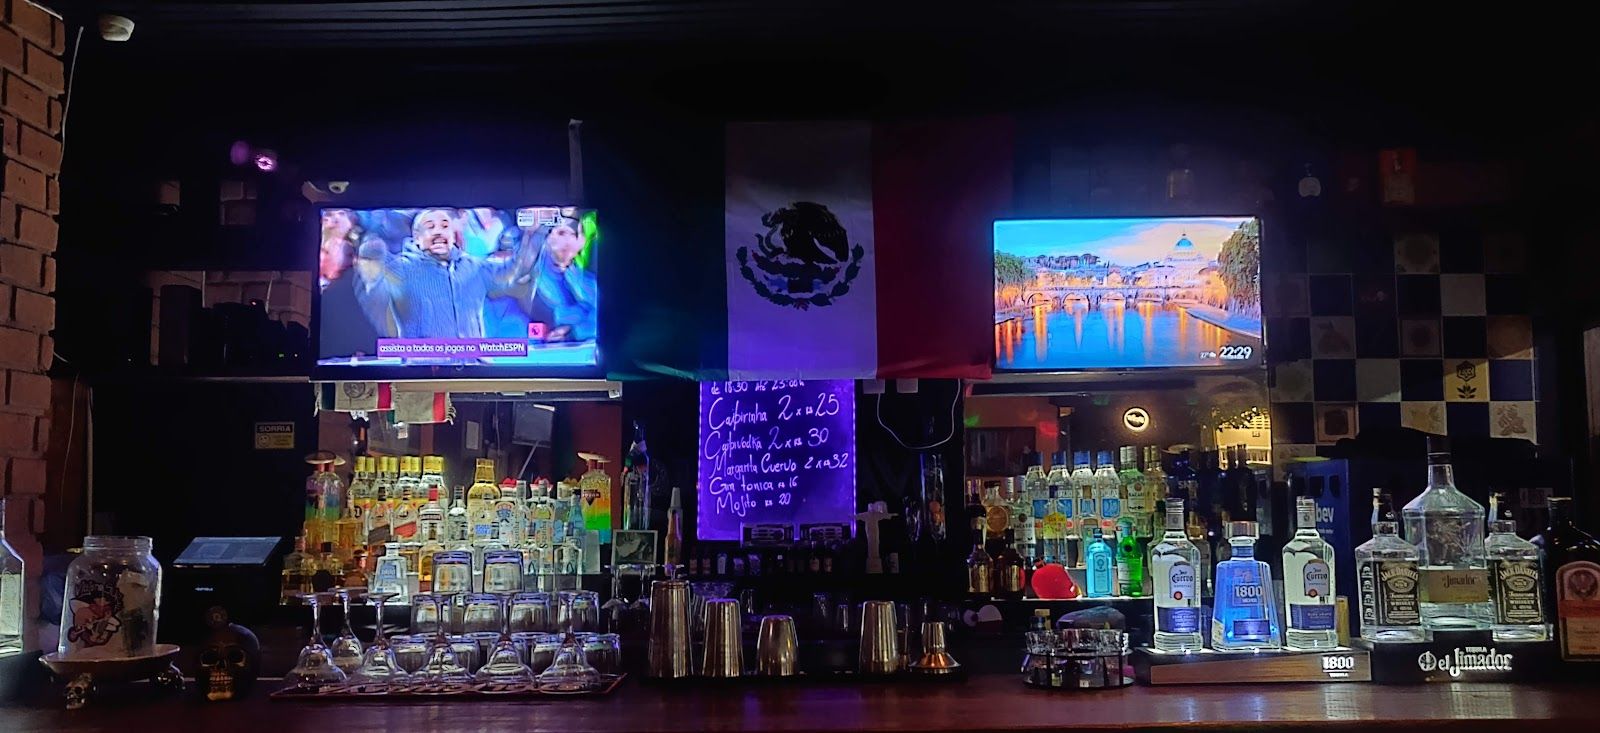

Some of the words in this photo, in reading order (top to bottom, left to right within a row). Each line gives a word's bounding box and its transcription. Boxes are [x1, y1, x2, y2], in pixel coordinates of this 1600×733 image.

[379, 344, 406, 352] assista
[413, 343, 434, 352] todos
[444, 344, 465, 355] jogos
[479, 343, 525, 352] WatchESPN
[1219, 346, 1252, 360] 22:29
[711, 381, 720, 395] de
[709, 397, 767, 431] Caipirinha
[778, 394, 793, 420] 2
[768, 426, 783, 450] 2
[808, 427, 829, 447] 30
[709, 451, 758, 480] Margarita
[761, 452, 797, 473] Cuervo
[804, 456, 814, 469] 2
[710, 476, 735, 495] Gin
[789, 475, 799, 488] 16
[716, 492, 757, 517] Mojito
[779, 492, 792, 505] 20
[1234, 585, 1262, 598] 1800
[1322, 656, 1355, 669] 1800
[1438, 654, 1450, 671] el
[1449, 647, 1513, 677] Jimador
